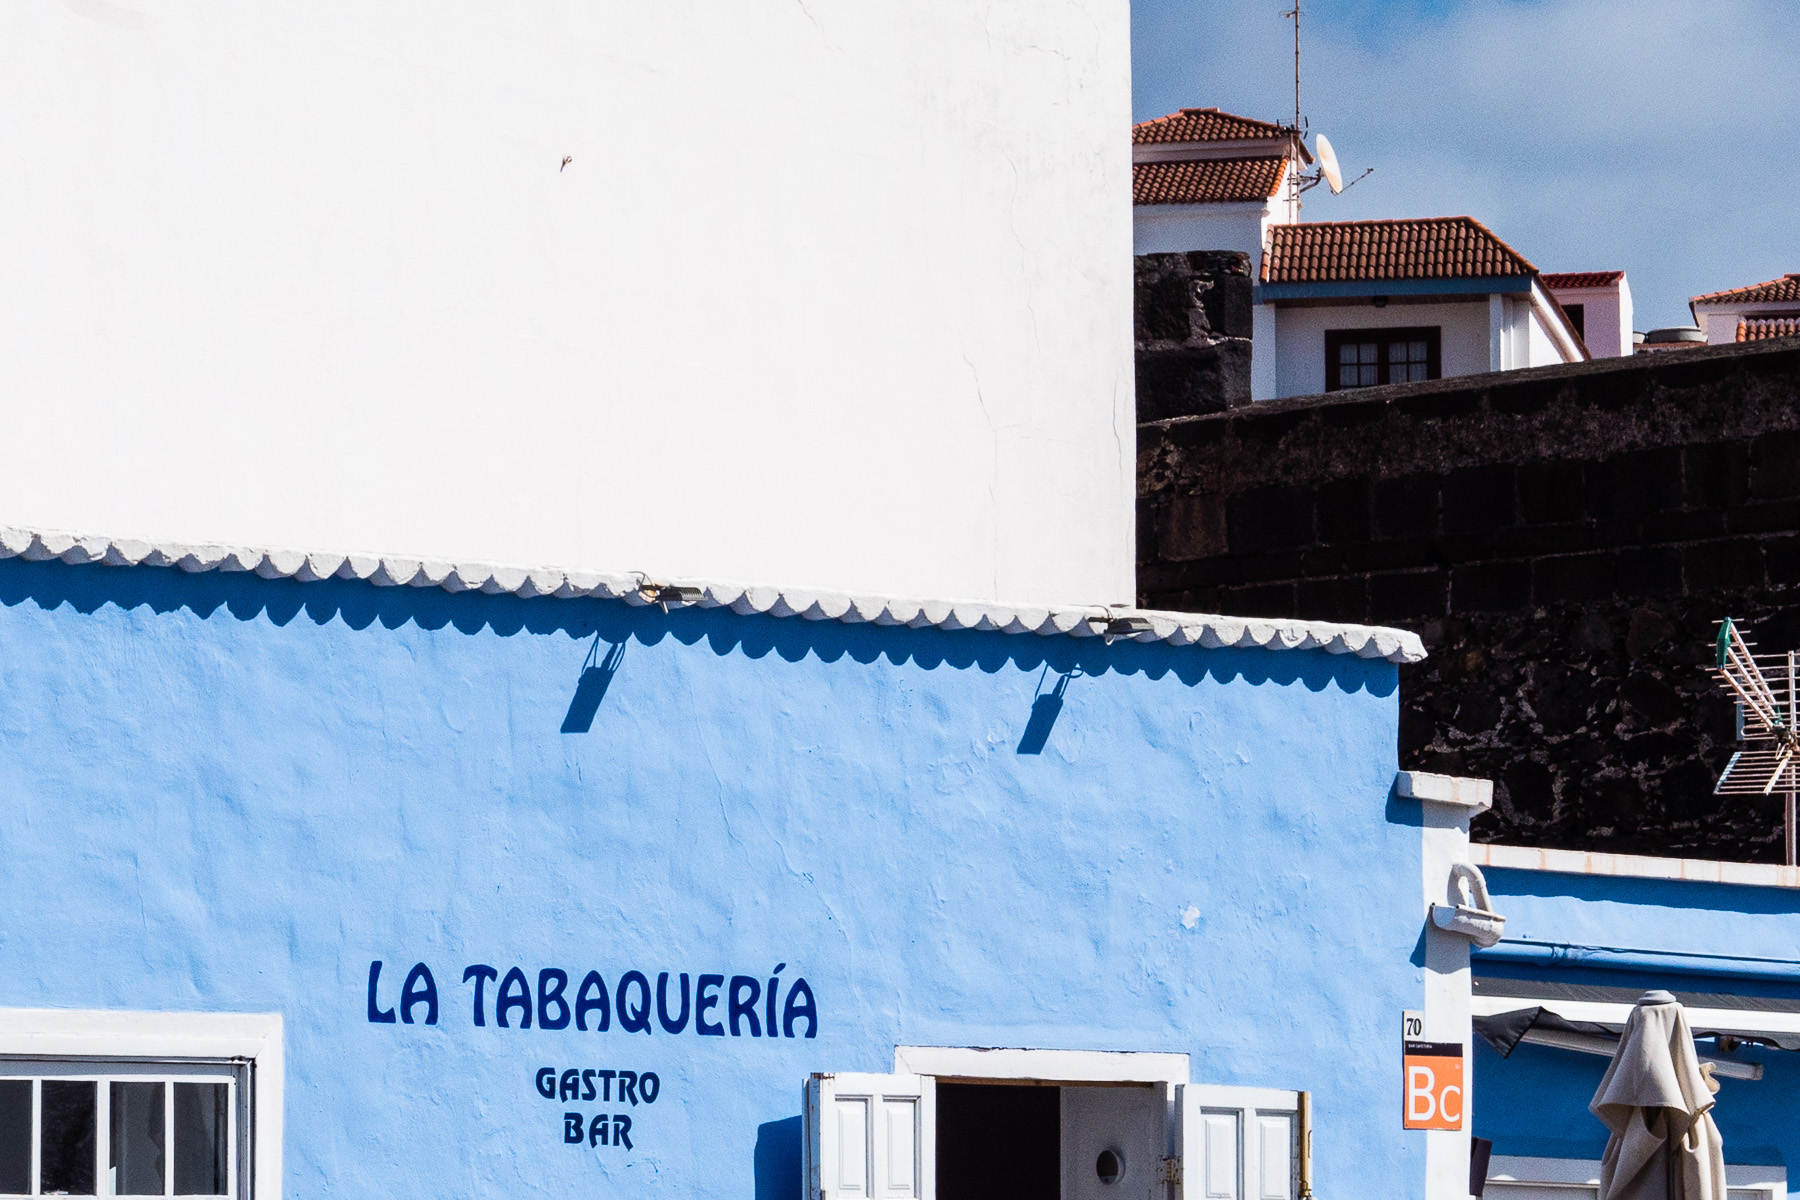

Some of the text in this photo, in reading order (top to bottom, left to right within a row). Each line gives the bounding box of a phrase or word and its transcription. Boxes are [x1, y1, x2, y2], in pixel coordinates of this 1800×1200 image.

[367, 959, 819, 1039] LA TABAQUERÍA
[1406, 1018, 1422, 1036] 70
[535, 1066, 660, 1105] GASTRO
[1408, 1065, 1461, 1122] Bc
[563, 1112, 634, 1151] BAR
